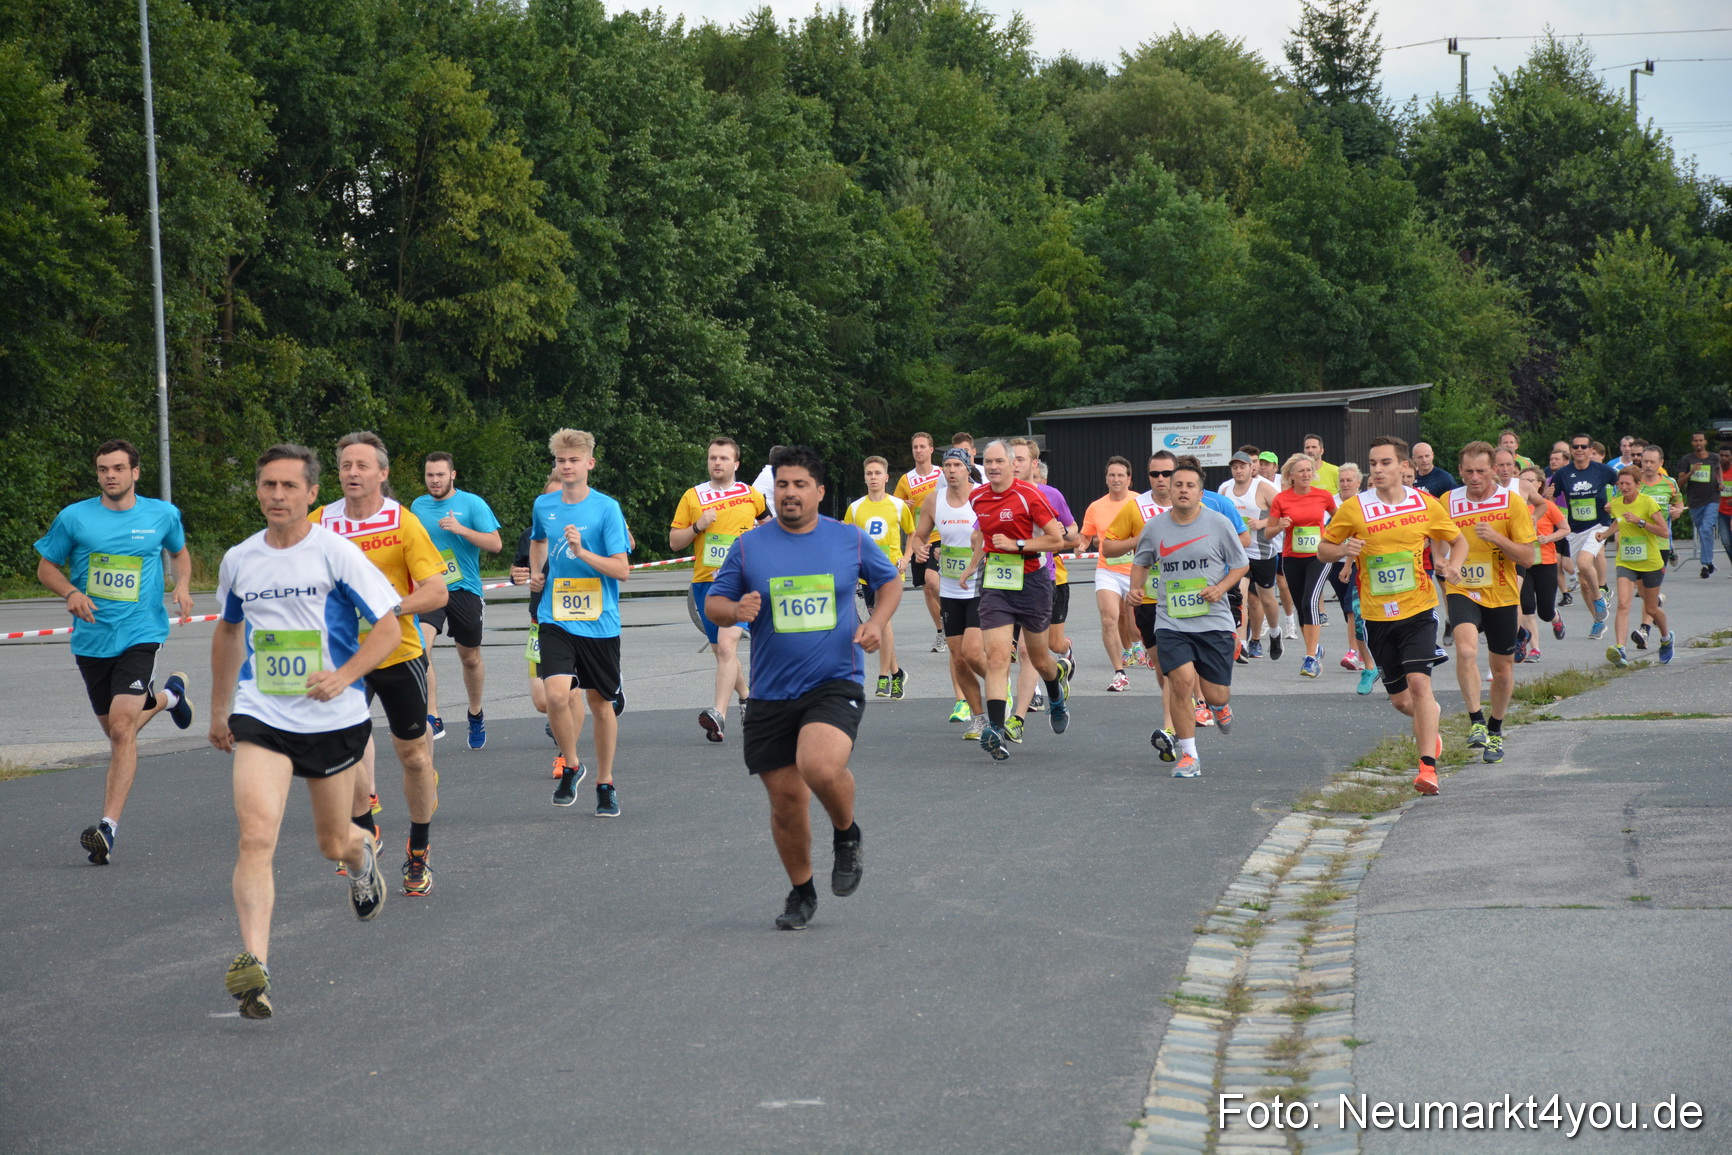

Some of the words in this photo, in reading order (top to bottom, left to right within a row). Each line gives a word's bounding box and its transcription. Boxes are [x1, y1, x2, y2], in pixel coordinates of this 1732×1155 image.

[1170, 435, 1198, 446] AST
[911, 486, 926, 496] MAX
[1479, 512, 1510, 523] BÖGL
[1576, 507, 1591, 515] 166
[869, 521, 883, 535] B
[1367, 520, 1397, 534] MAX
[1400, 514, 1429, 526] BÖGL
[360, 535, 401, 551] BÖGL
[1297, 536, 1316, 546] 970
[1624, 546, 1642, 555] 599
[946, 558, 966, 571] 575
[1163, 561, 1179, 572] JUST
[1183, 560, 1196, 571] DO
[996, 567, 1012, 580] 35
[1377, 568, 1406, 583] 897
[1460, 566, 1485, 578] 910
[93, 571, 135, 588] 1086
[245, 587, 316, 602] DELPHI
[1171, 593, 1205, 607] 1658
[562, 595, 590, 609] 801
[779, 596, 829, 616] 1667
[266, 655, 306, 677] 300
